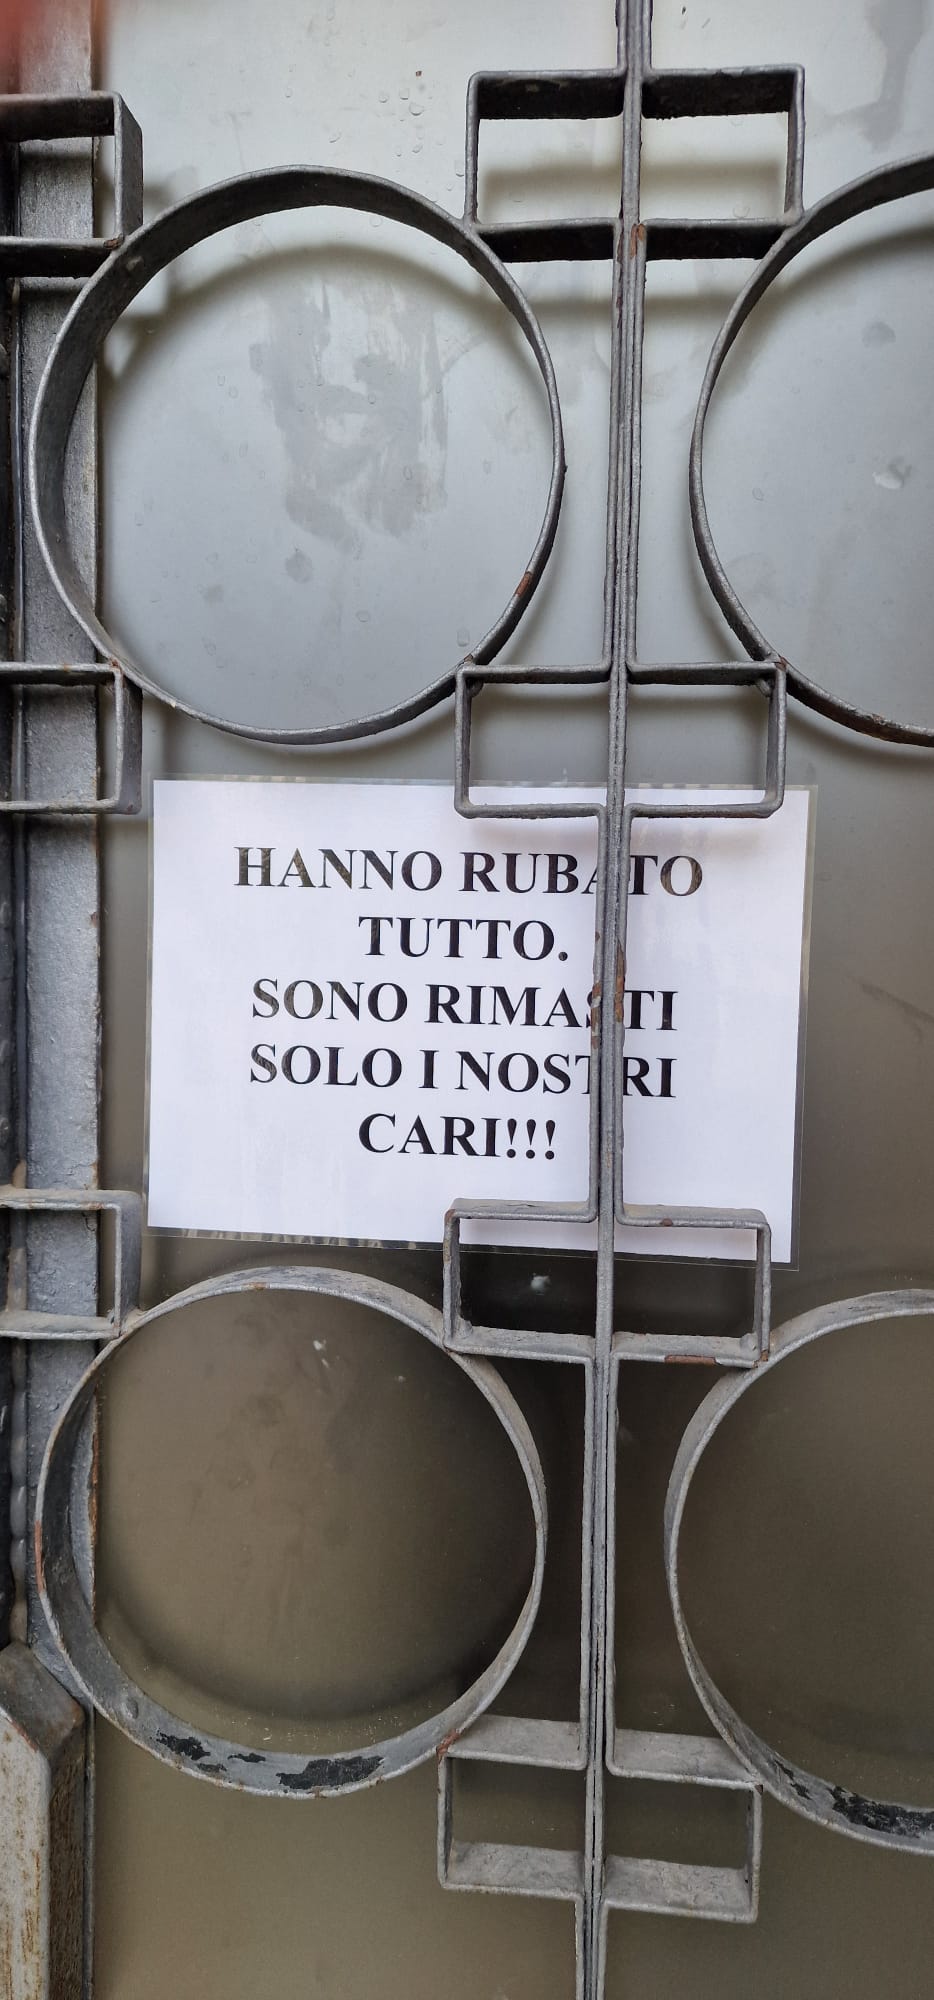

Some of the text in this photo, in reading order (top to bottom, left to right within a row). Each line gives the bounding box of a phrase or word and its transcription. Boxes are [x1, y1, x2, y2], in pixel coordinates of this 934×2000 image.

[234, 846, 442, 892] HANNO
[358, 916, 569, 962] TUTTO.
[251, 978, 678, 1031] SONO RIMATI
[249, 1043, 402, 1088] SOLO
[419, 1049, 438, 1089] I
[358, 1113, 557, 1160] CARI!!!
